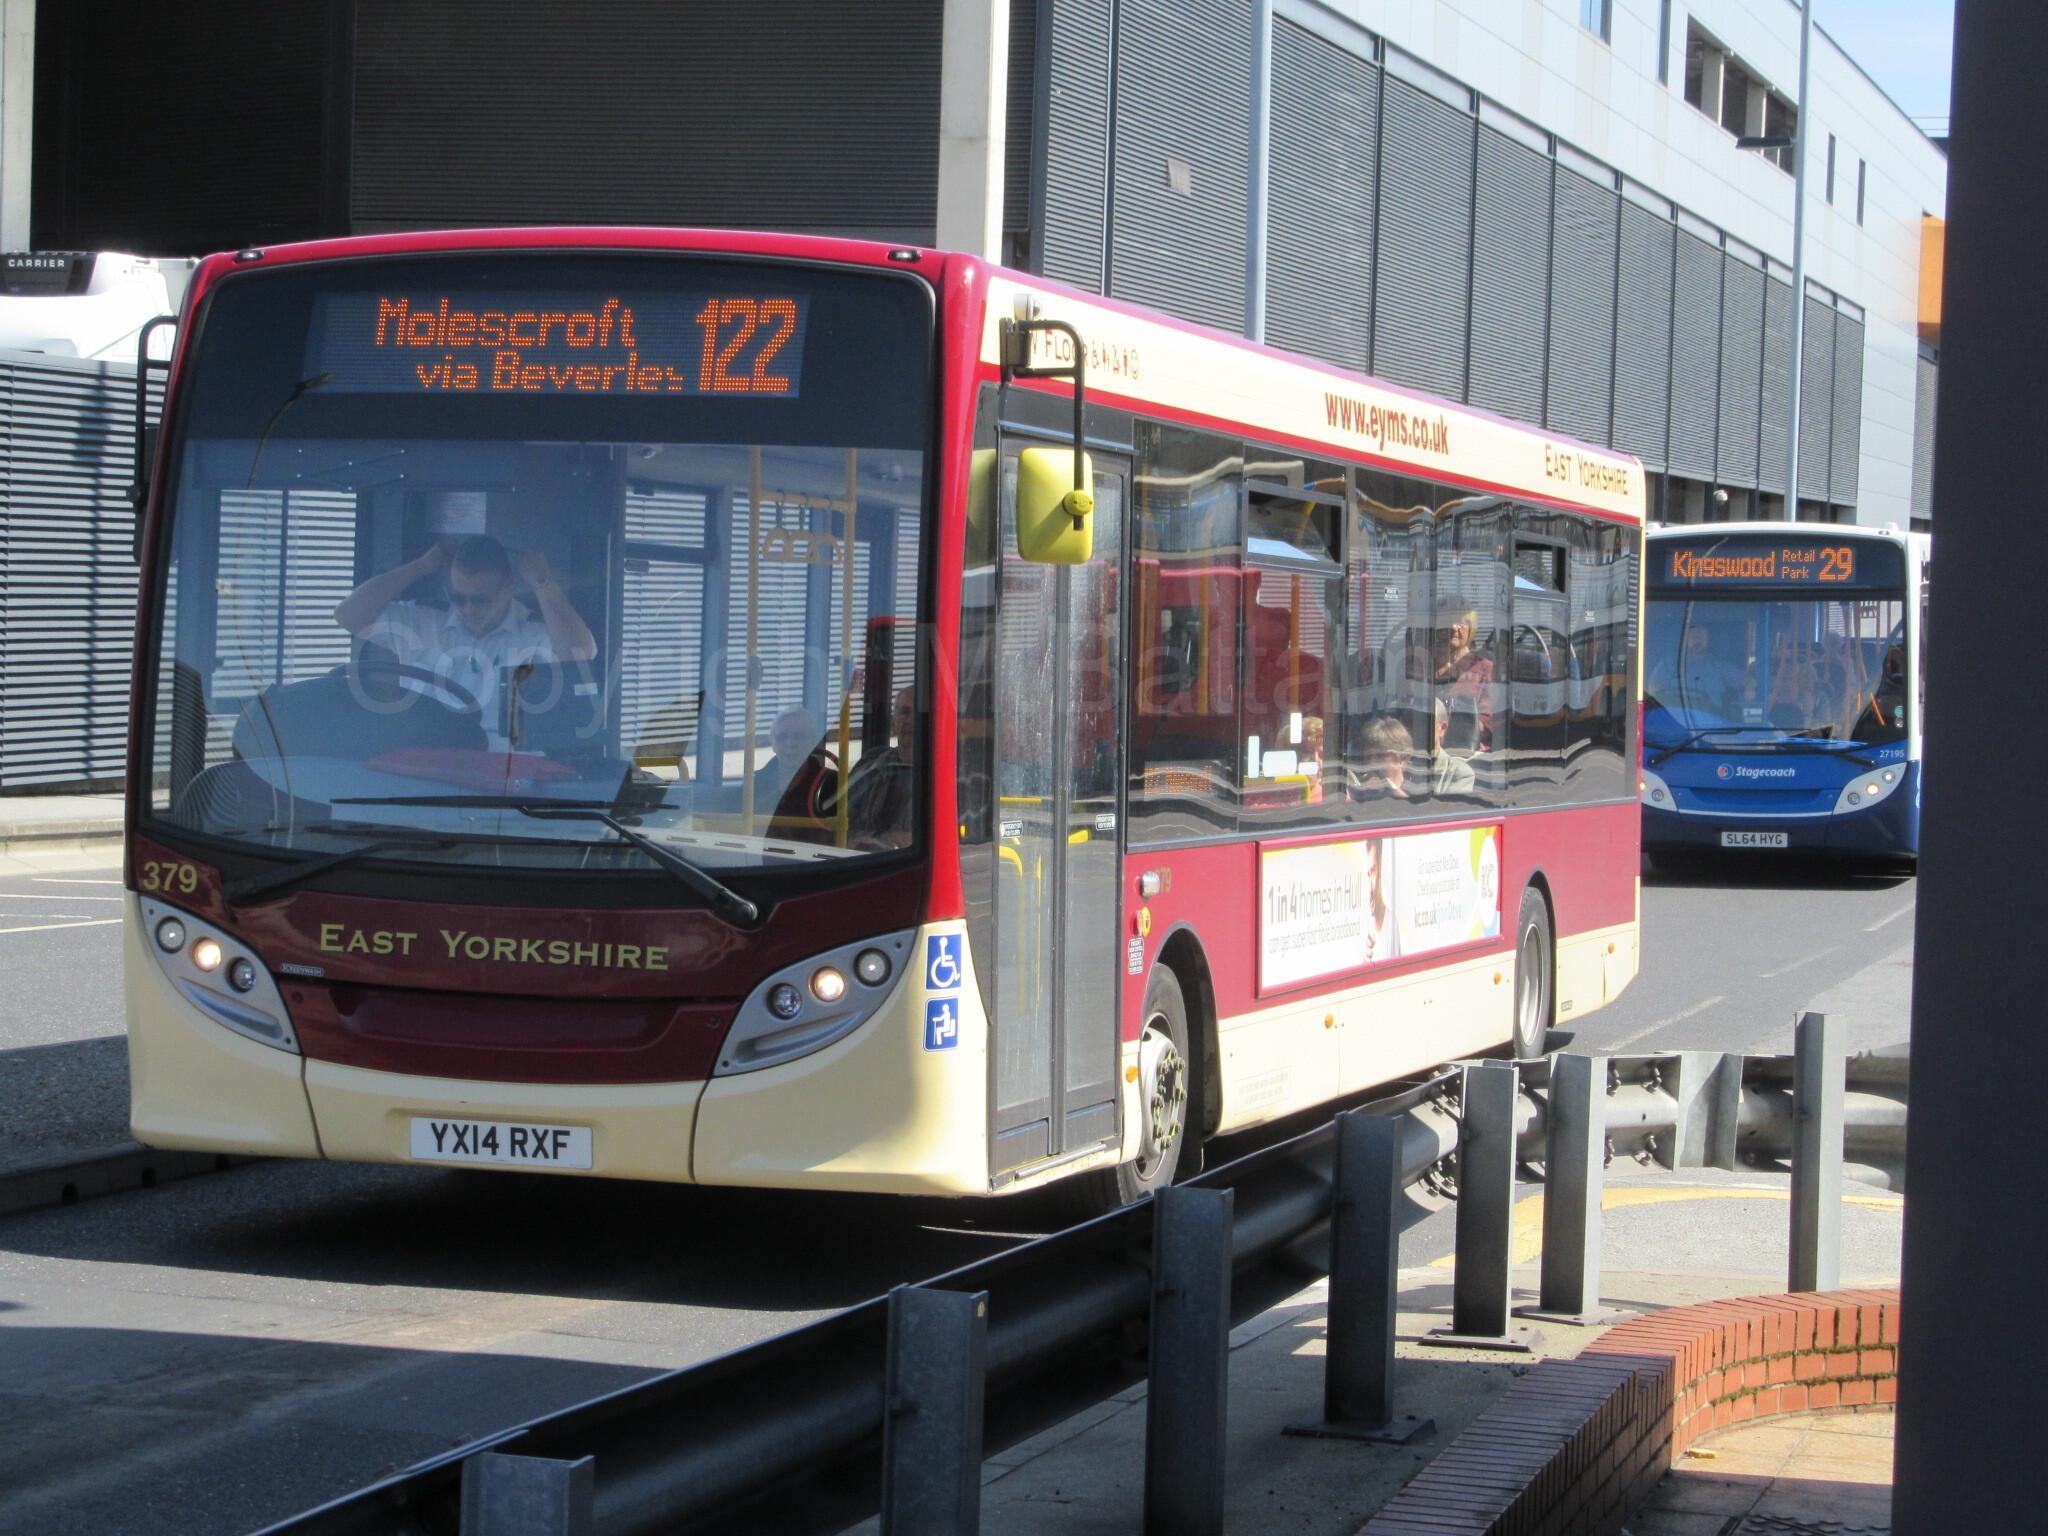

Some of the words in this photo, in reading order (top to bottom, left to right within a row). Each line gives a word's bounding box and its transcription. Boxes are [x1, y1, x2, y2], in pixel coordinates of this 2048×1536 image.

[8, 258, 65, 268] CARRIER
[375, 297, 636, 347] Molescroft
[695, 299, 796, 391] 122
[415, 355, 477, 389] via
[1325, 392, 1449, 455] www.eyms.co.uk
[1545, 443, 1571, 482] EAST
[1576, 452, 1628, 495] YORKSHIRE
[1673, 551, 1775, 578] Kingswood
[1819, 548, 1853, 580] 29
[1782, 550, 1815, 562] Retail
[1782, 566, 1809, 579] Park
[1879, 749, 1905, 759] 27195
[1736, 766, 1796, 779] Stagecoach
[1726, 833, 1757, 845] SL64
[1760, 833, 1783, 845] HYG
[143, 861, 198, 893] 379
[1278, 885, 1288, 923] in
[1290, 882, 1297, 920] 4
[1300, 881, 1332, 918] homes
[1334, 878, 1343, 913] in
[1345, 871, 1361, 911] Hull
[320, 923, 417, 955] EAST
[440, 929, 669, 970] YORKSHIRE
[430, 1122, 499, 1156] YX14
[510, 1126, 570, 1159] RXF
